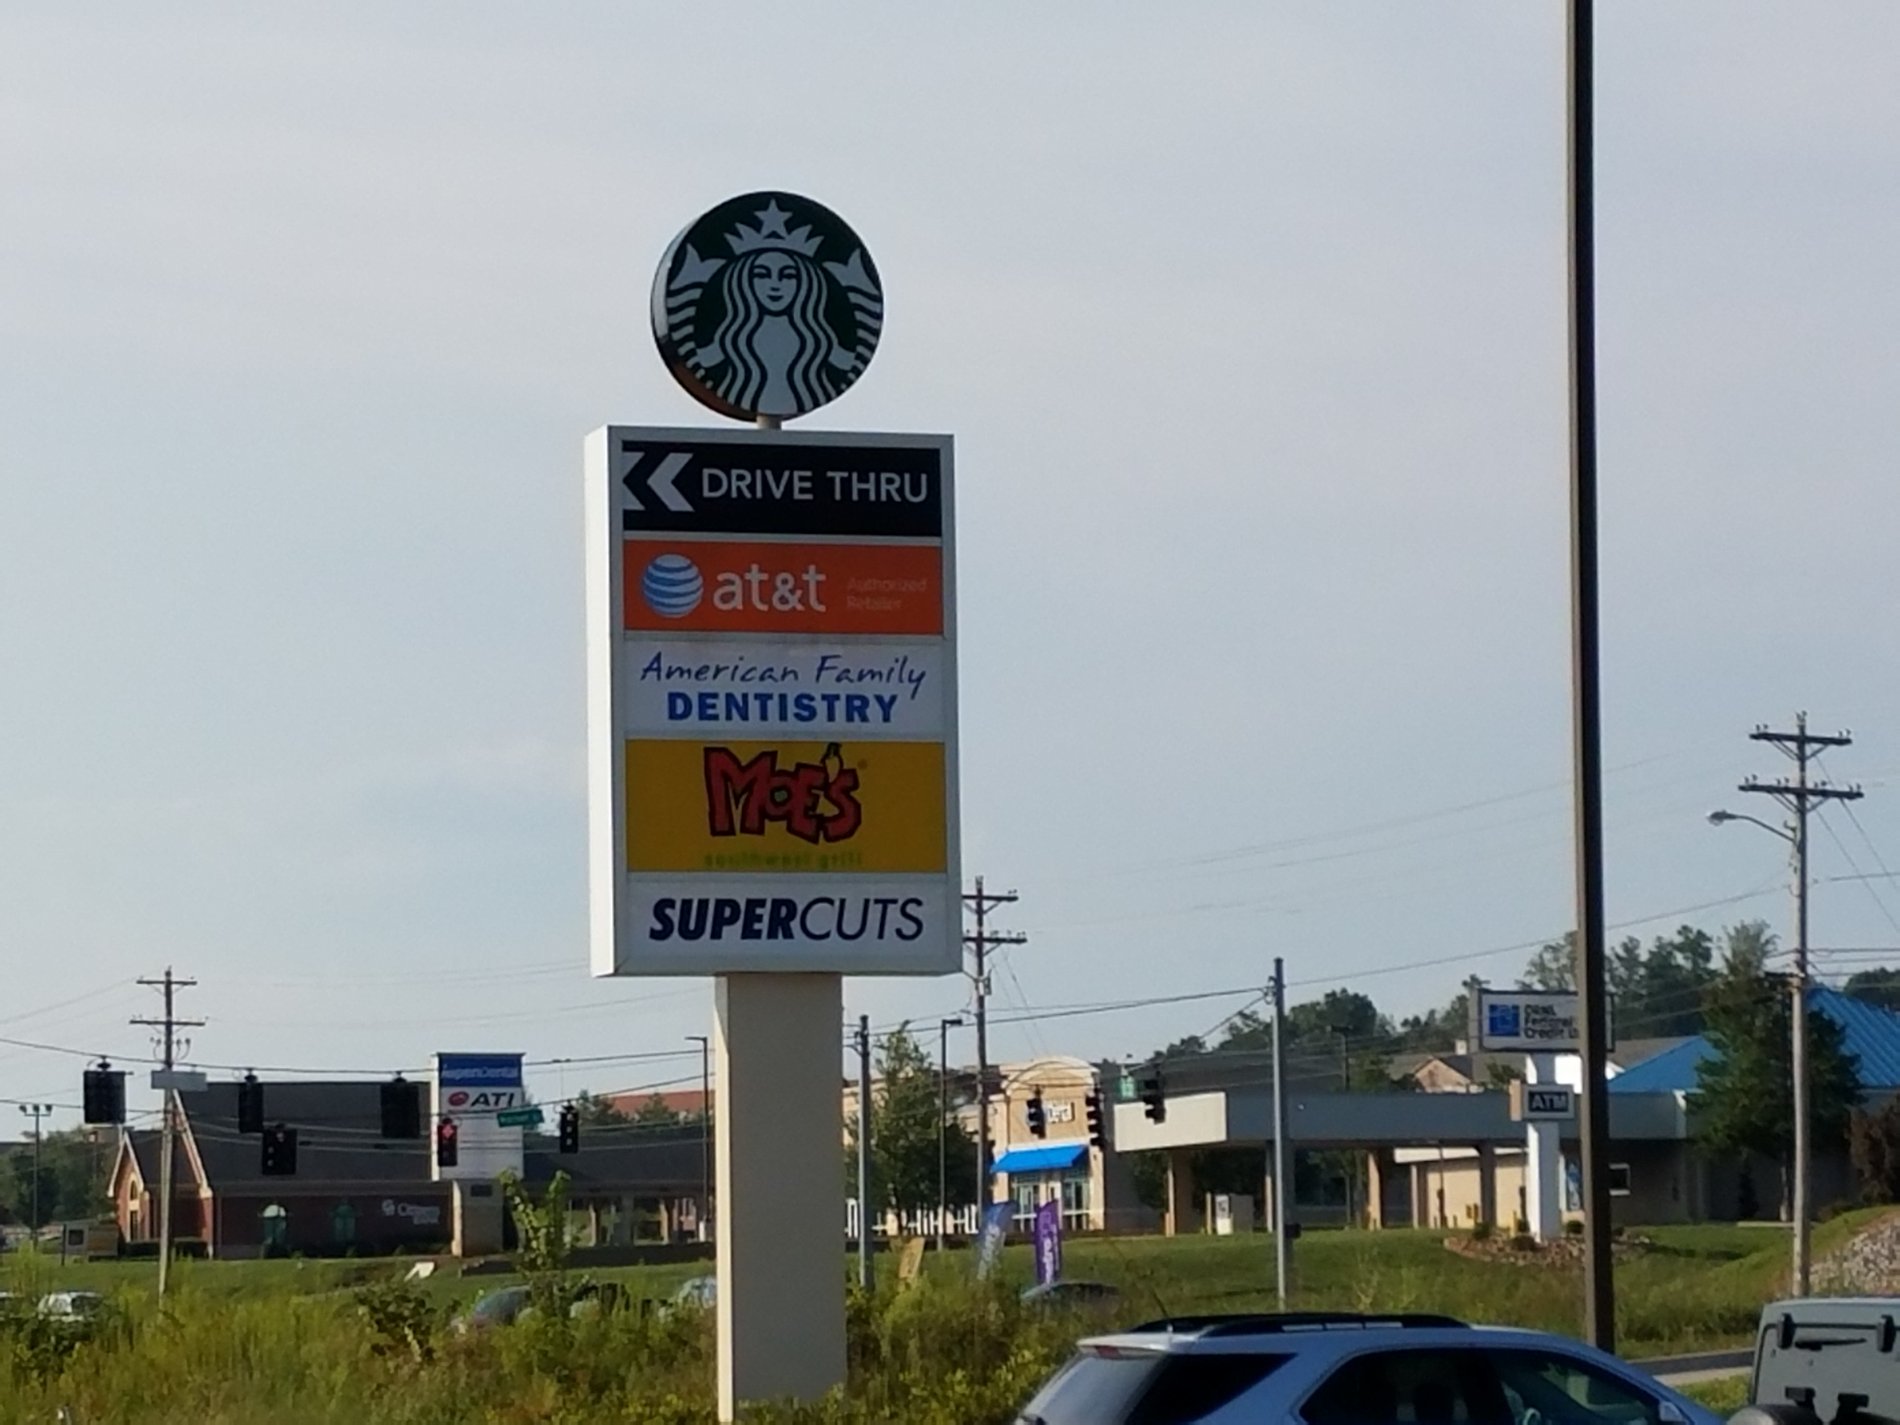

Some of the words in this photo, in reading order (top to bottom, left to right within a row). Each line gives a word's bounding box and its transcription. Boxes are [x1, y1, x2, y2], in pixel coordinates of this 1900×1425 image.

[702, 467, 814, 500] DRIVE
[827, 471, 928, 502] THRU
[713, 563, 826, 613] at&t
[640, 651, 799, 683] American
[815, 655, 926, 700] Family
[667, 692, 898, 723] DENTISTRY
[649, 897, 924, 941] SUPERCUTS
[1525, 1027, 1565, 1039] Credit
[470, 1092, 515, 1107] ATI
[1532, 1094, 1567, 1109] ATM
